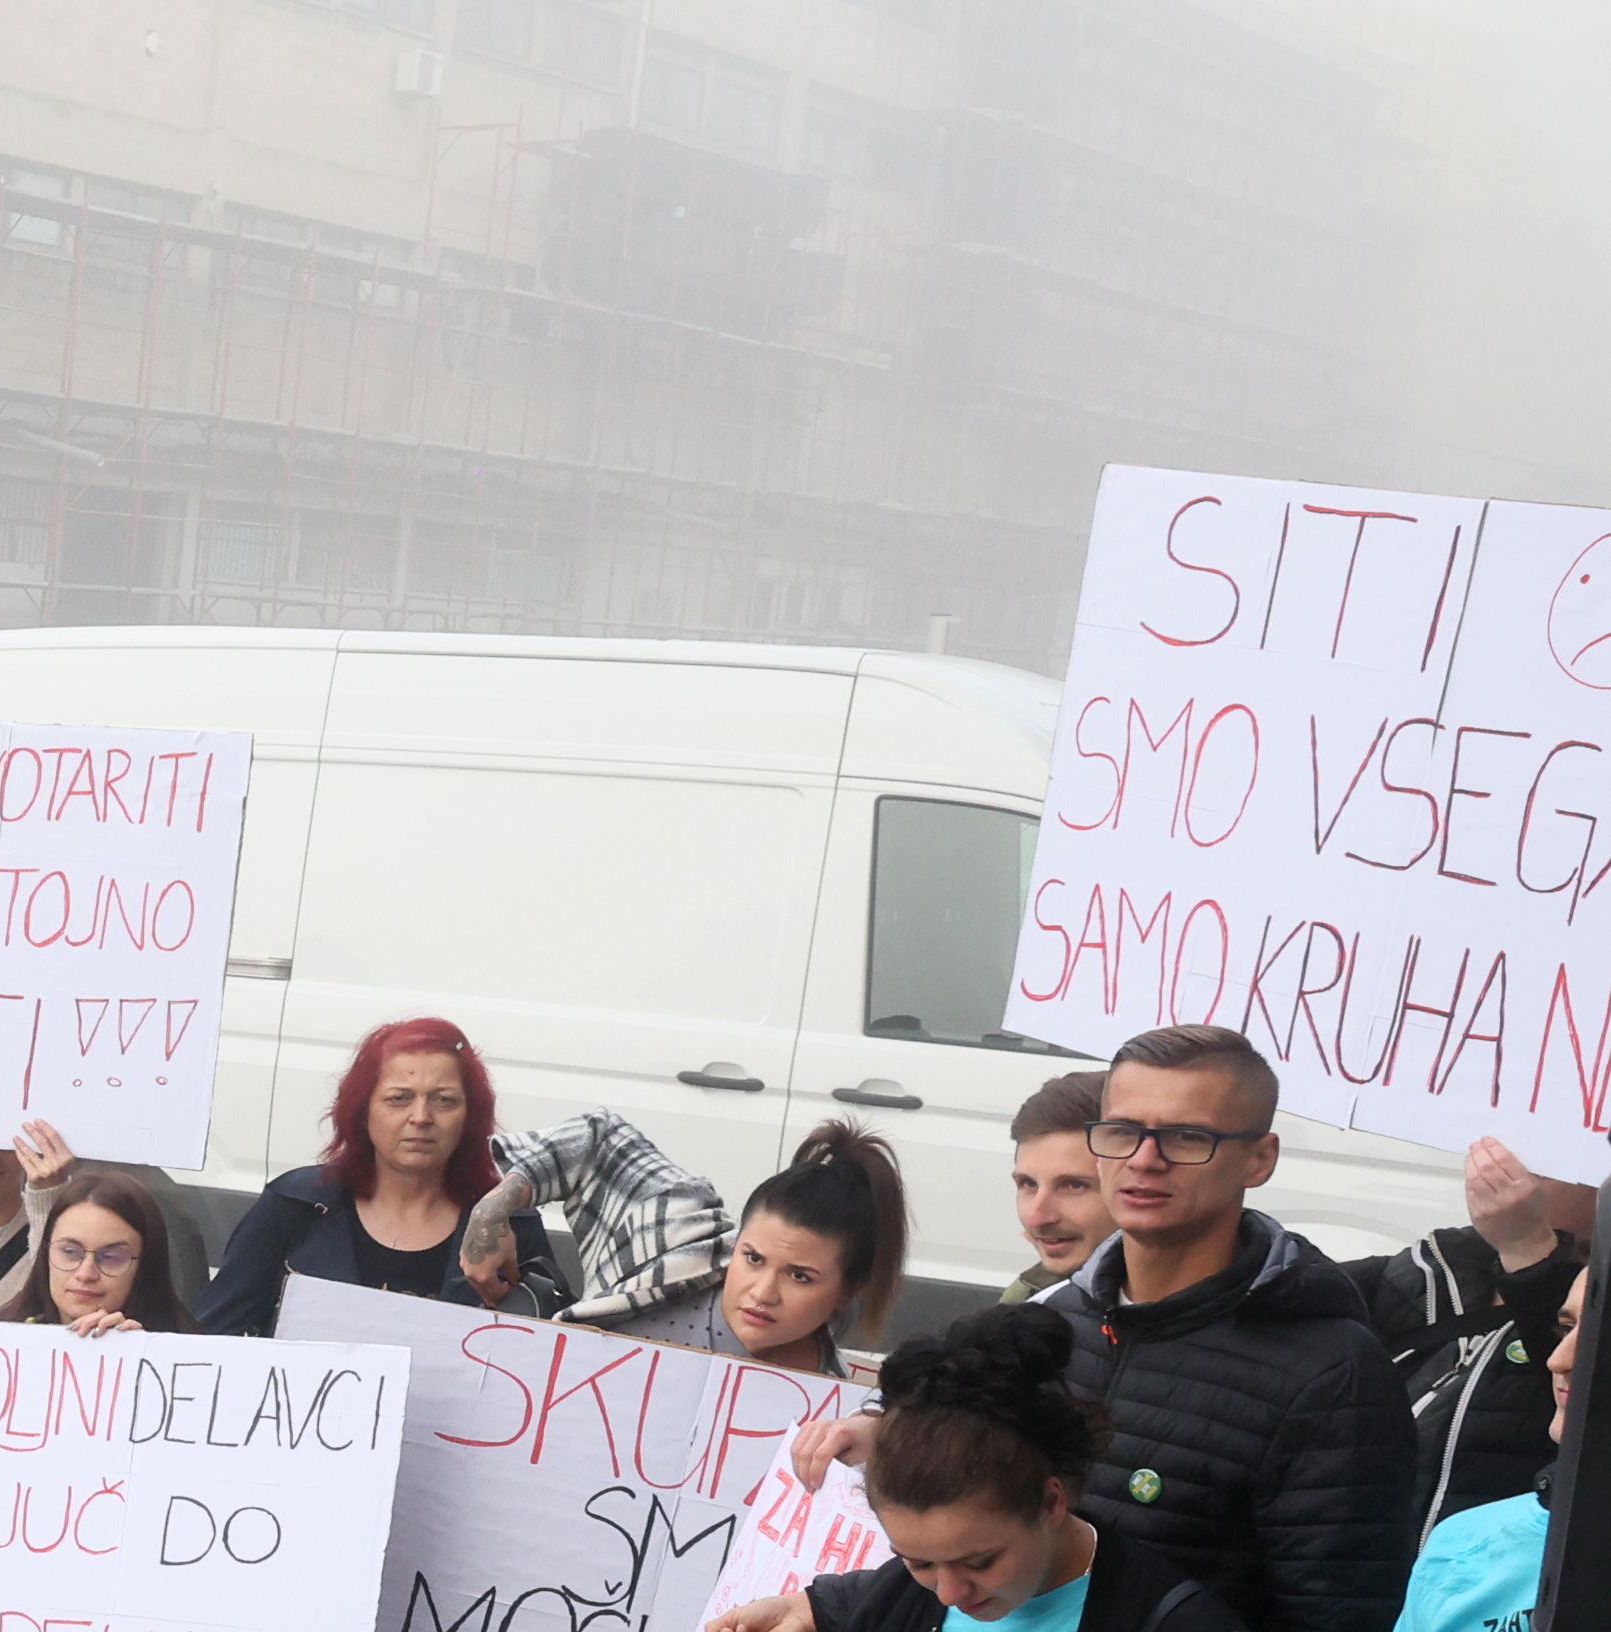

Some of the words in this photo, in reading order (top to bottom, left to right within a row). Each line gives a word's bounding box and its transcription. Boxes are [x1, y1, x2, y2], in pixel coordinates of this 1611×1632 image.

[1140, 496, 1461, 673] SITI
[1058, 696, 1260, 848] SMO
[1310, 715, 1611, 926] VSEG
[1020, 878, 1229, 1027] SAMO
[1241, 915, 1508, 1108] KRUHA
[1529, 963, 1611, 1133] N
[129, 1357, 385, 1451] DELAVCI
[159, 1495, 283, 1567] DO
